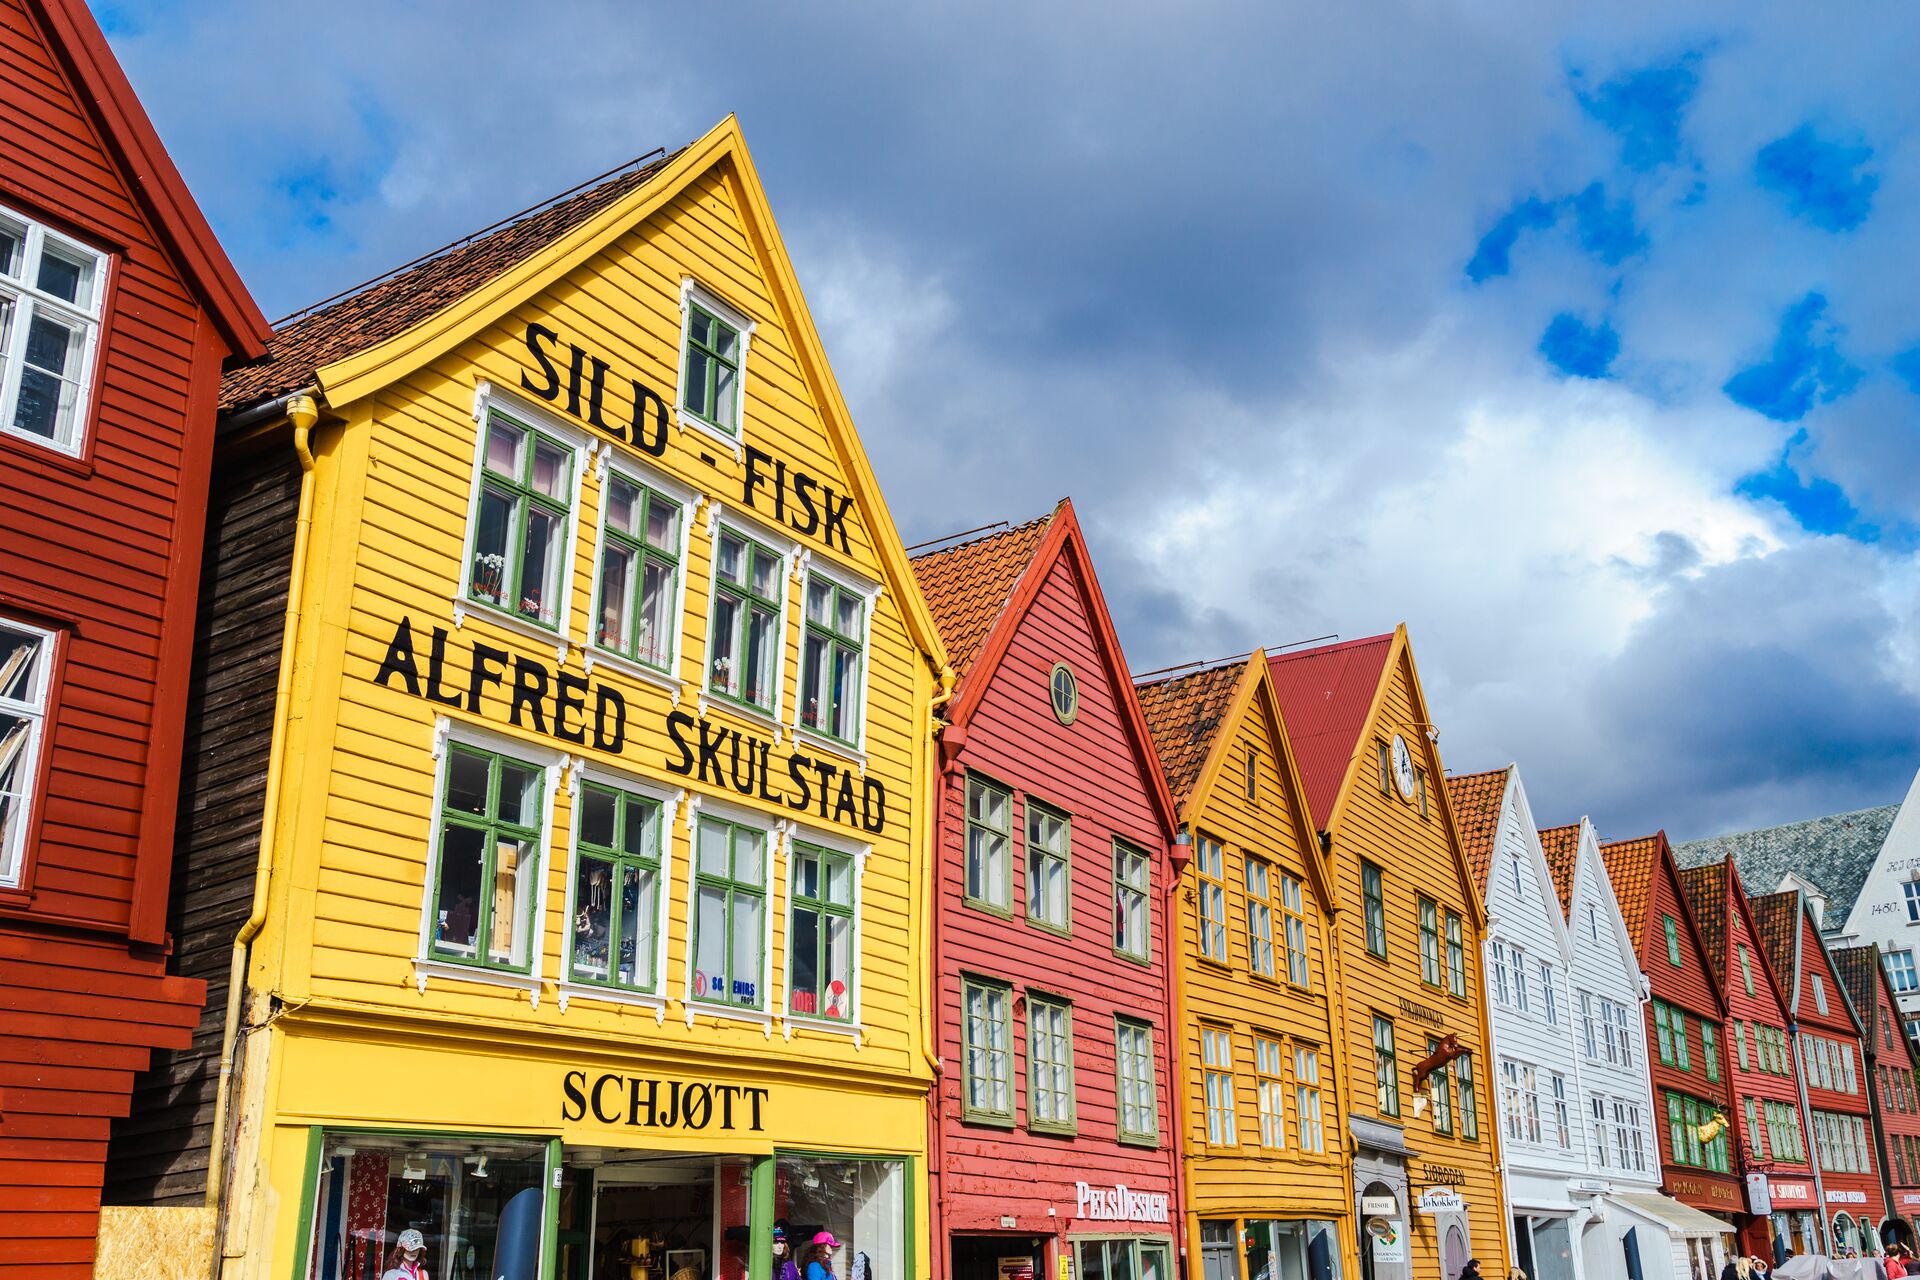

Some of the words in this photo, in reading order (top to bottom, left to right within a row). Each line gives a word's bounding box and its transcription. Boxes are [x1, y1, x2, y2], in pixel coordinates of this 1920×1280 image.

[521, 322, 669, 458] SILD
[742, 443, 855, 557] FISK
[374, 615, 629, 755] ALFRED
[665, 710, 886, 835] SKULSTAD
[712, 976, 755, 997] SOENIRS
[562, 1070, 769, 1131] SCHJØTT
